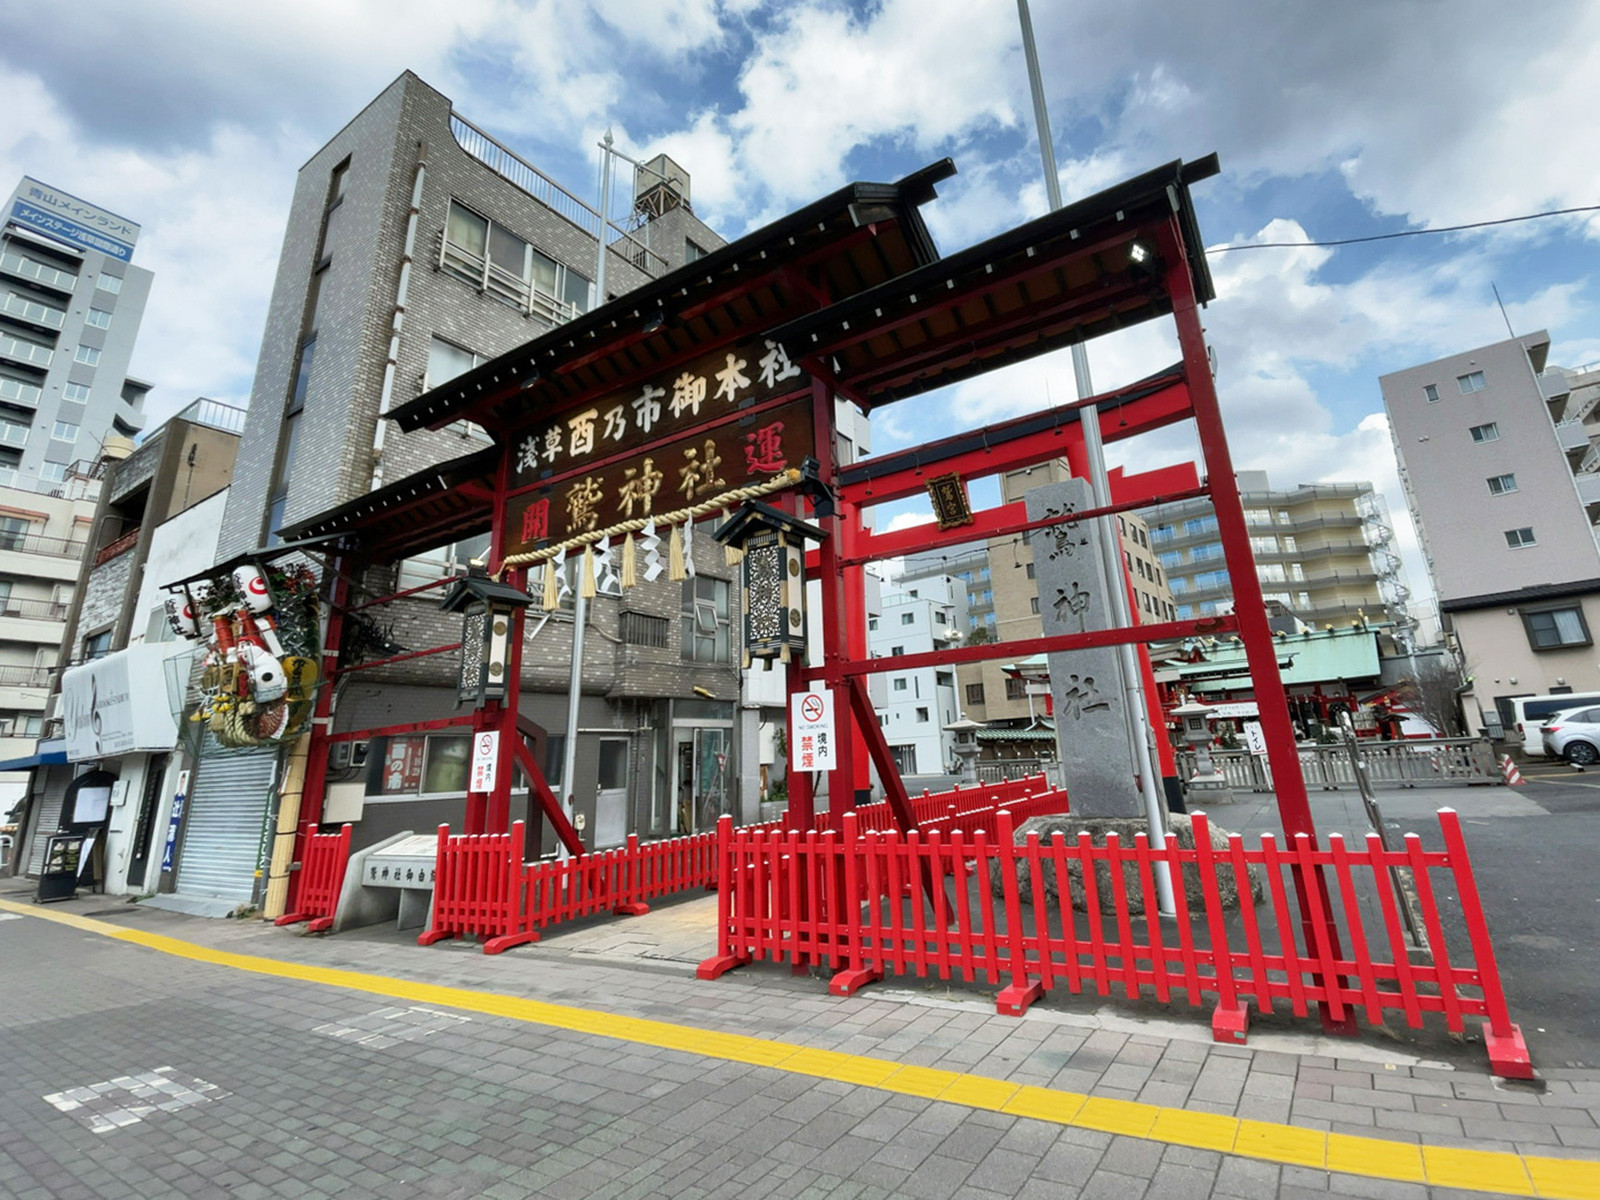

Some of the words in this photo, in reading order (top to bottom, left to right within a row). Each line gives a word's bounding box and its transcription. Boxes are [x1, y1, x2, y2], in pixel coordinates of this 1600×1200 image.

[29, 187, 132, 235] 青山メインランド
[801, 735, 814, 768] 禁煙
[817, 732, 828, 757] 境内
[1251, 730, 1261, 750] トイレ
